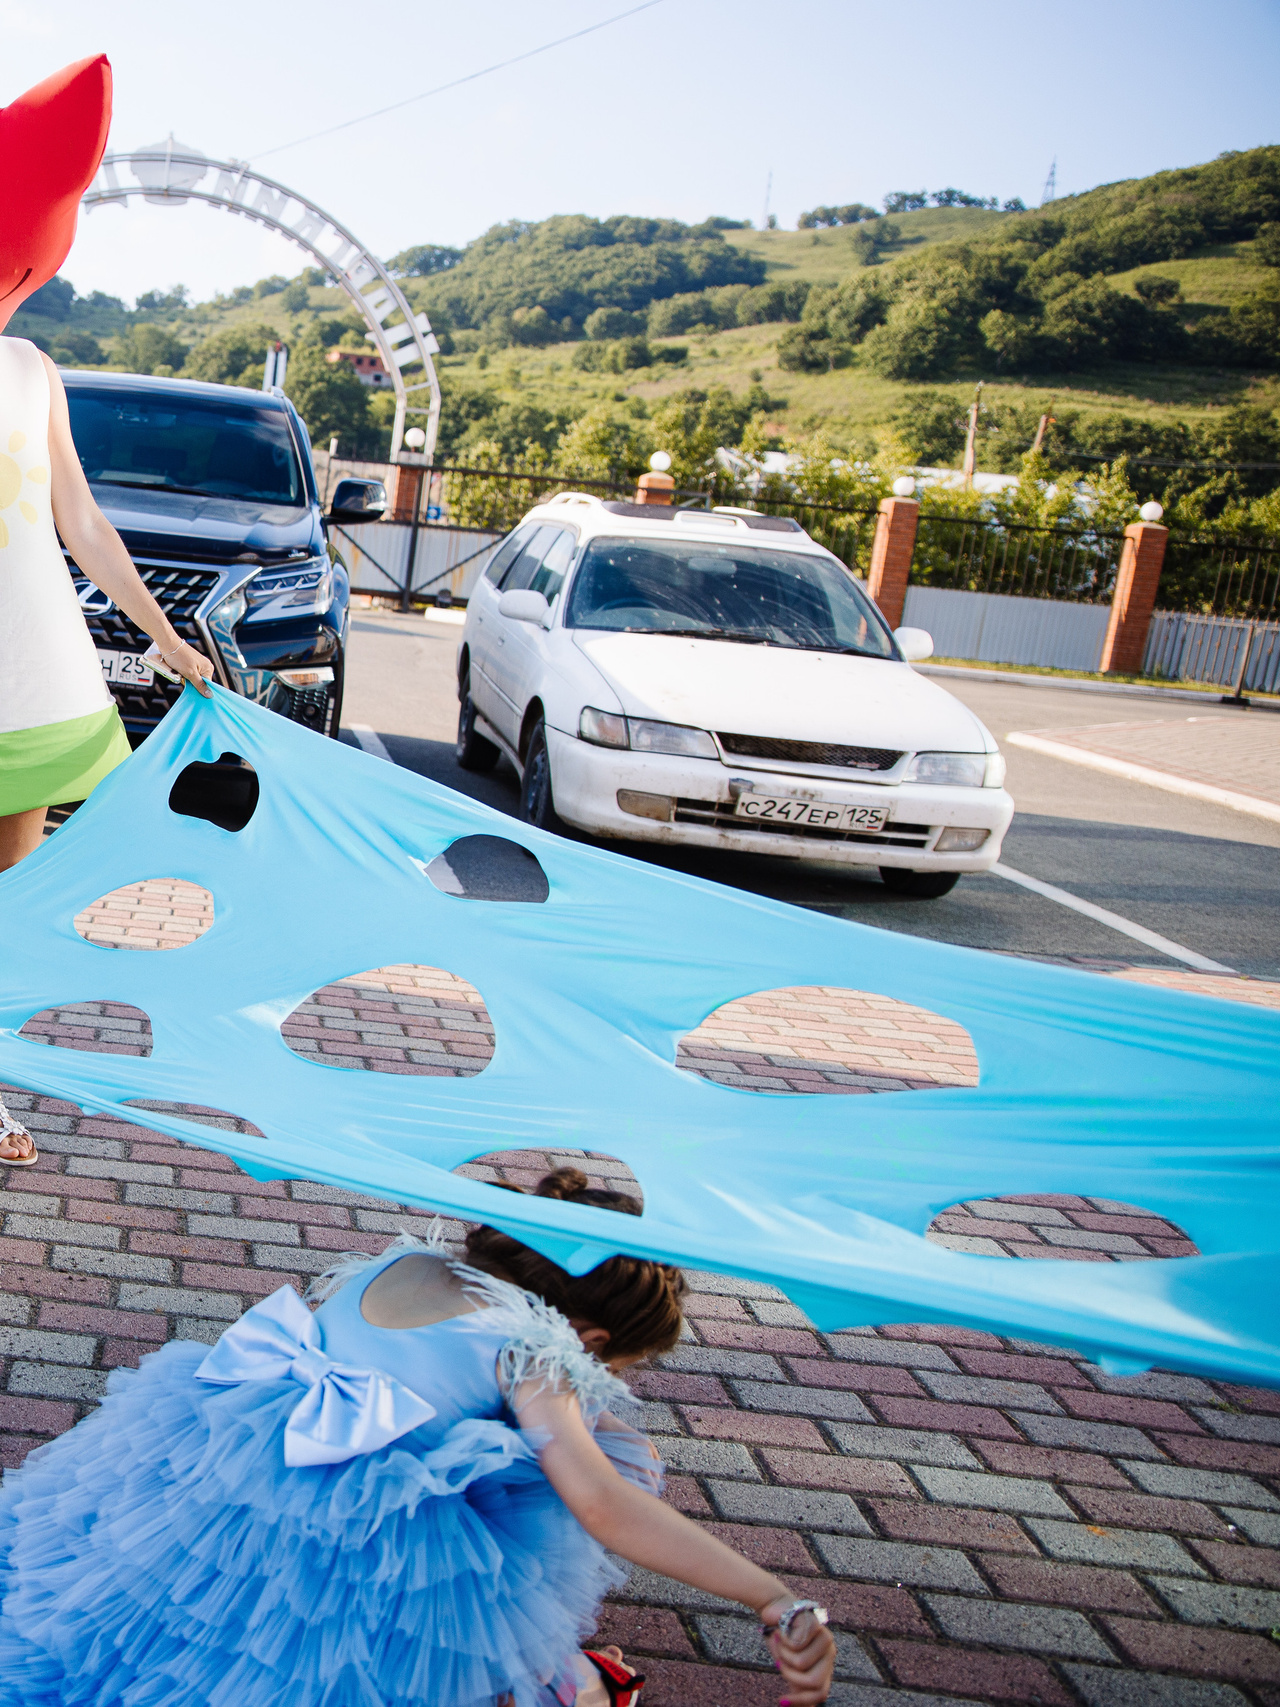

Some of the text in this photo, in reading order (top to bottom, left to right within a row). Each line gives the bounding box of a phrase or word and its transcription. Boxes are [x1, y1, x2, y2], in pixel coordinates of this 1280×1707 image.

[121, 655, 145, 674] 25
[119, 673, 137, 681] RUS
[745, 800, 881, 824] С247ЕР 125
